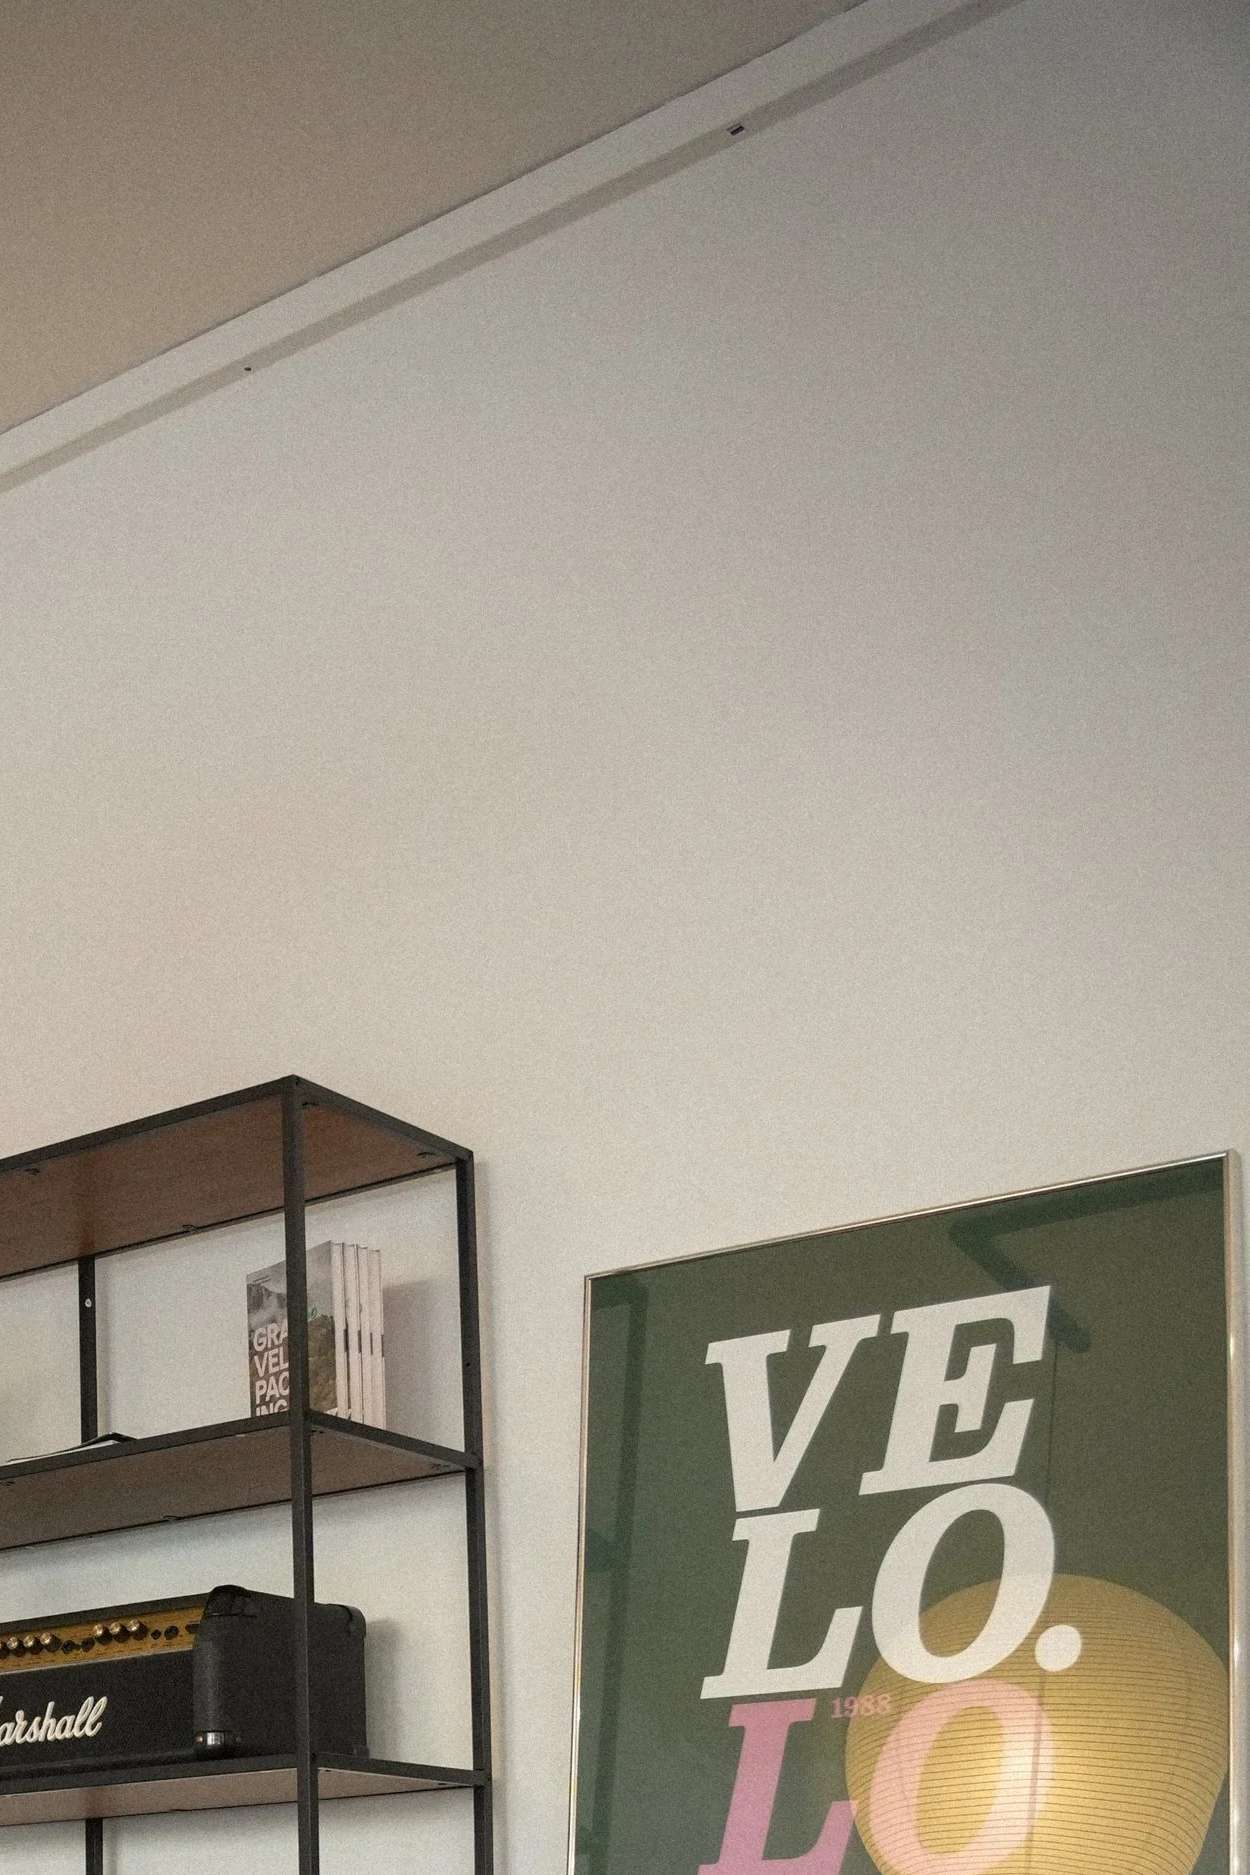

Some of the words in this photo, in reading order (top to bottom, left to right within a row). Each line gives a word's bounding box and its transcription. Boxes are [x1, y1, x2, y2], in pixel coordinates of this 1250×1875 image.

[704, 1285, 1052, 1512] VE
[700, 1481, 1084, 1701] LO.
[830, 1693, 893, 1719] 1988
